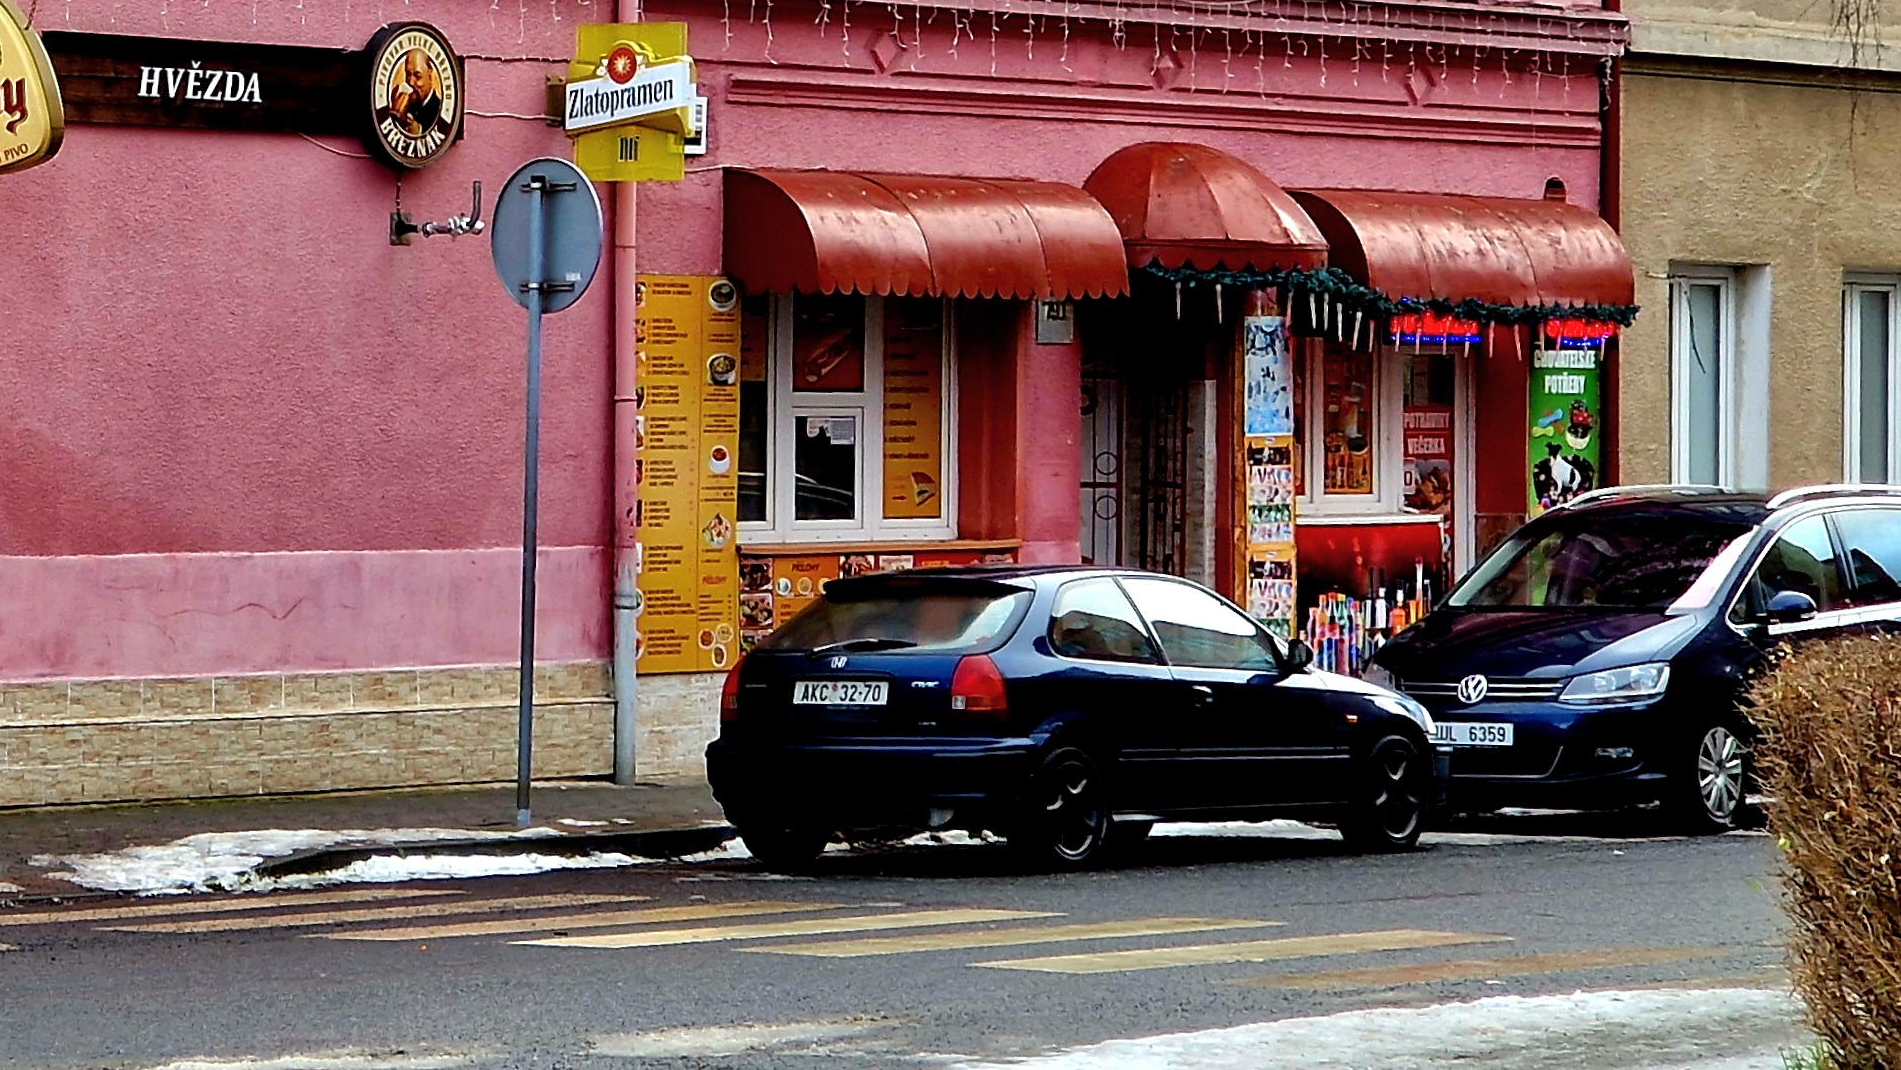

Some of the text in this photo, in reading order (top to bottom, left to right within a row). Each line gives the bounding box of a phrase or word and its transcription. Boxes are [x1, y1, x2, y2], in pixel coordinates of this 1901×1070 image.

[379, 38, 404, 86] PIVOVAR
[137, 61, 263, 103] HVĚZDA
[569, 79, 674, 120] Zlatopramen
[4, 143, 30, 161] PIVO
[801, 684, 829, 702] AKC
[1469, 726, 1506, 743] 6359
